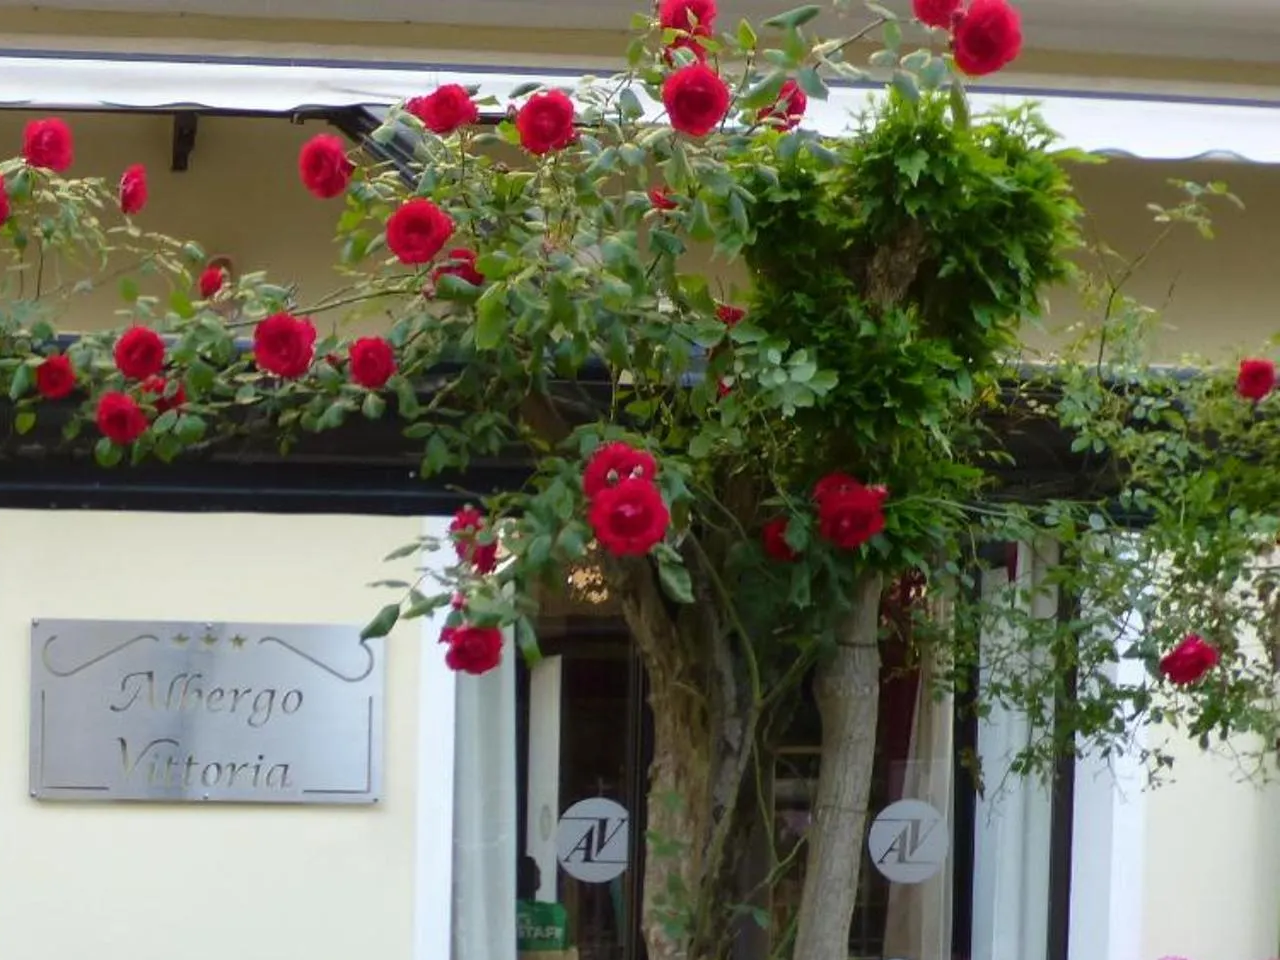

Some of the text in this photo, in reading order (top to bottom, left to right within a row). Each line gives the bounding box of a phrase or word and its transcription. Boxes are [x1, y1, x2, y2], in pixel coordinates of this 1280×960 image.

[110, 670, 303, 728] Albergo
[117, 737, 293, 790] Vittoria
[564, 817, 628, 864] AV
[876, 818, 941, 866] AV
